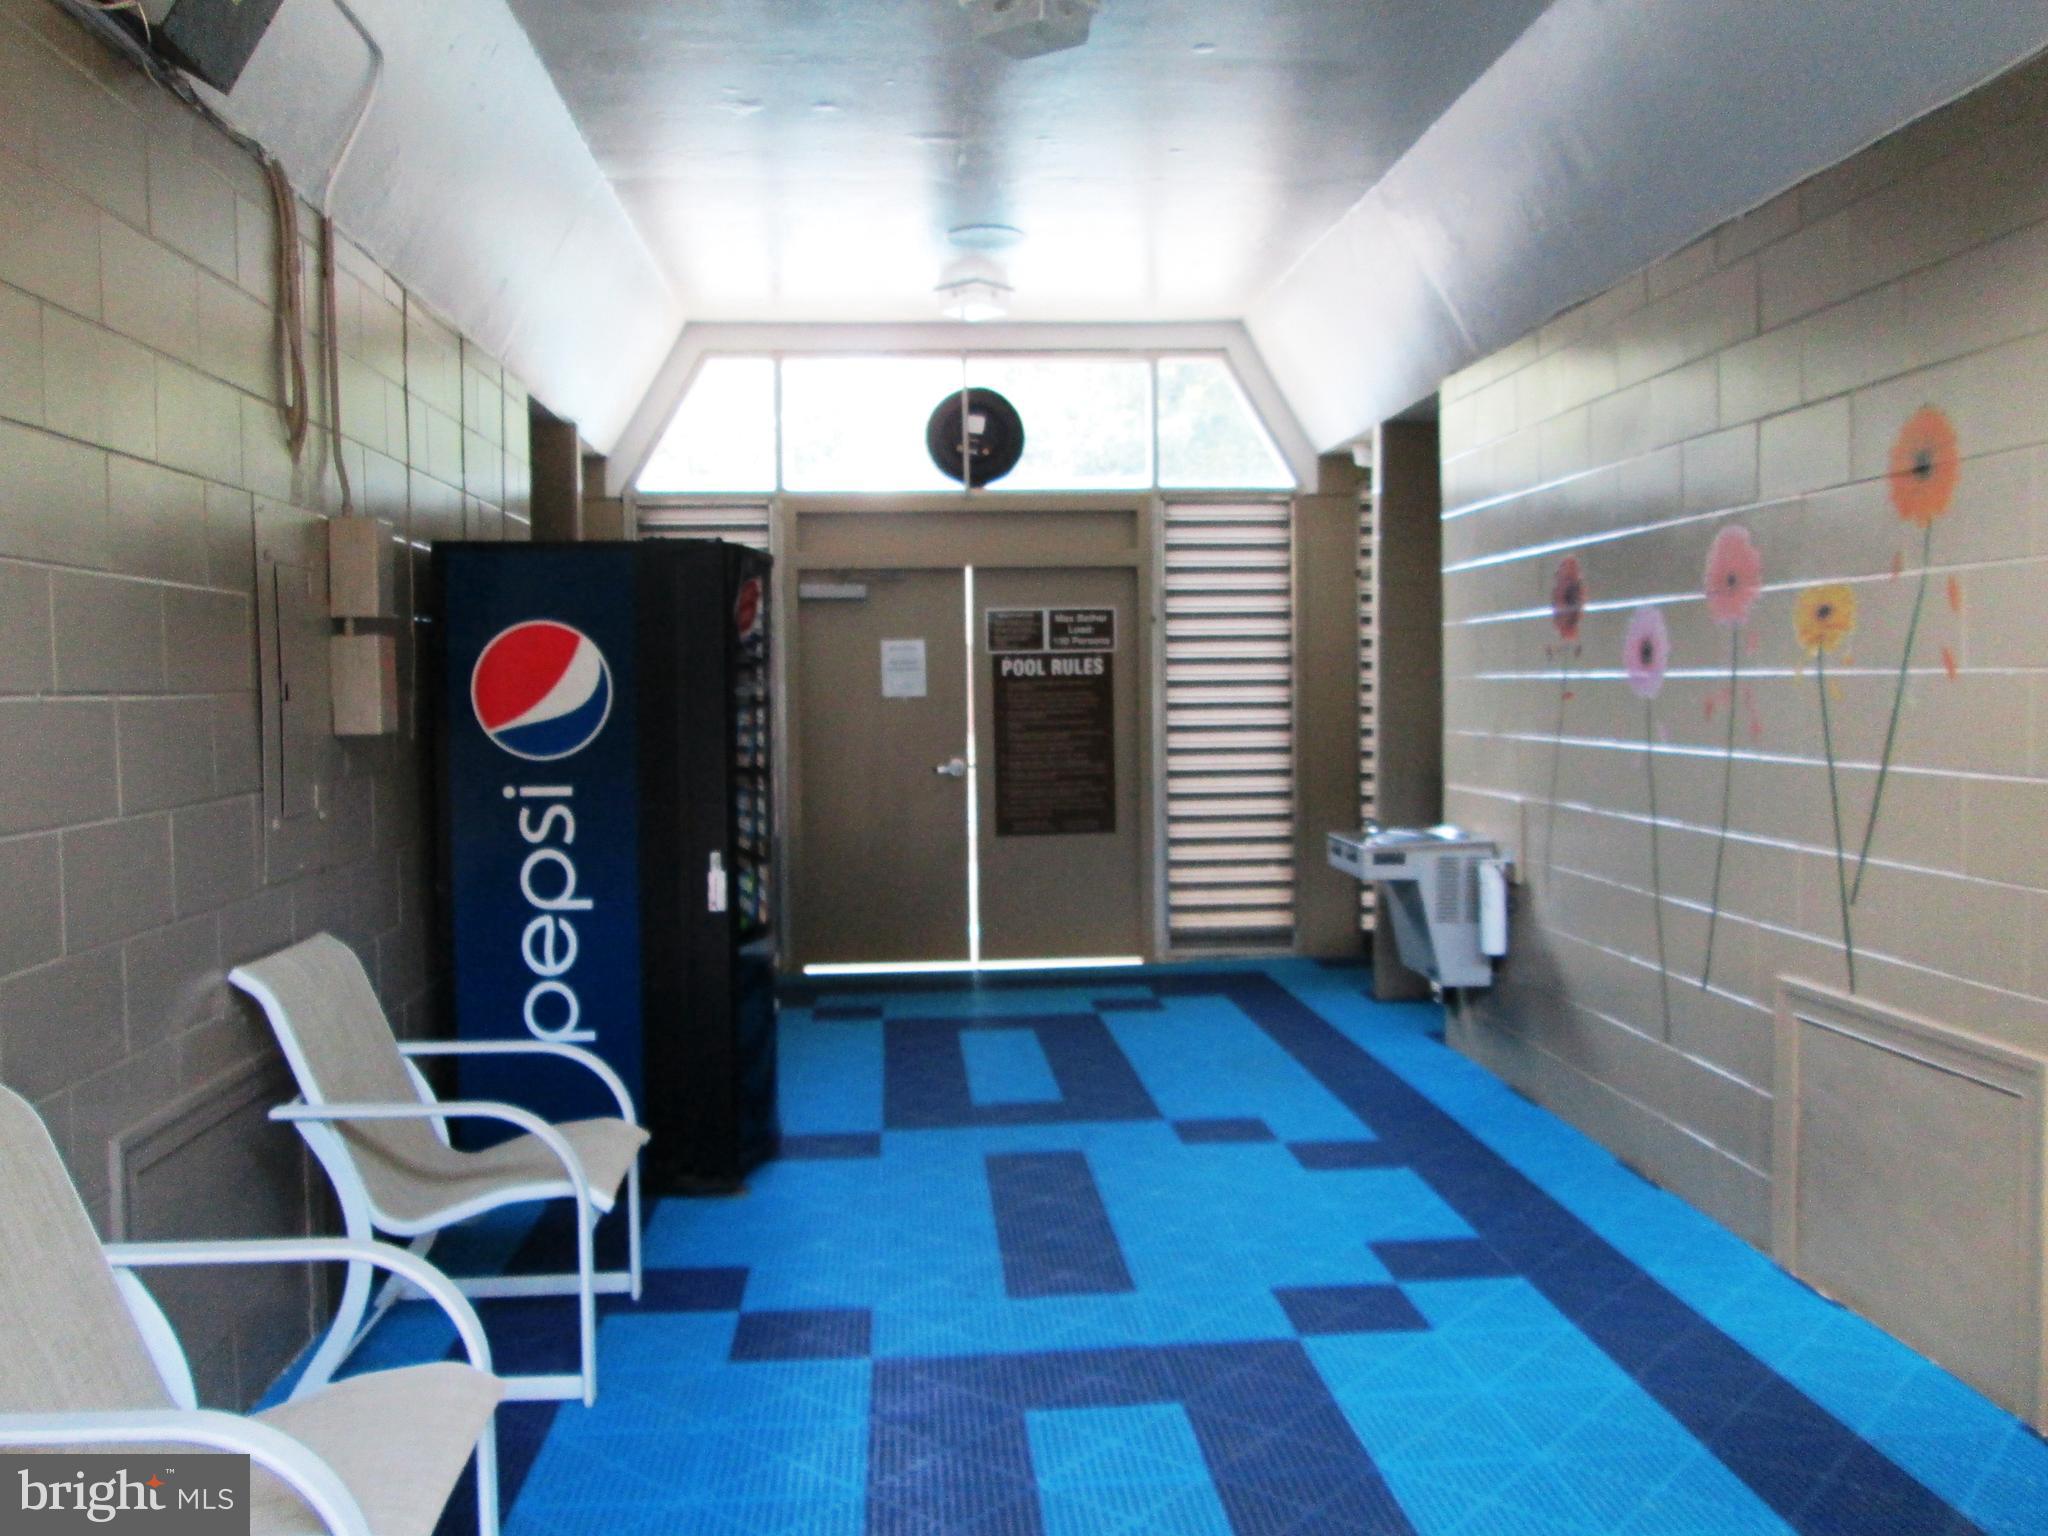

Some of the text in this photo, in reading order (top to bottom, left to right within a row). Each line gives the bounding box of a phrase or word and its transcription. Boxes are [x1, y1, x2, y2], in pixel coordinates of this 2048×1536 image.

[1001, 656, 1104, 677] POOL RULES
[502, 785, 596, 1043] pepsi
